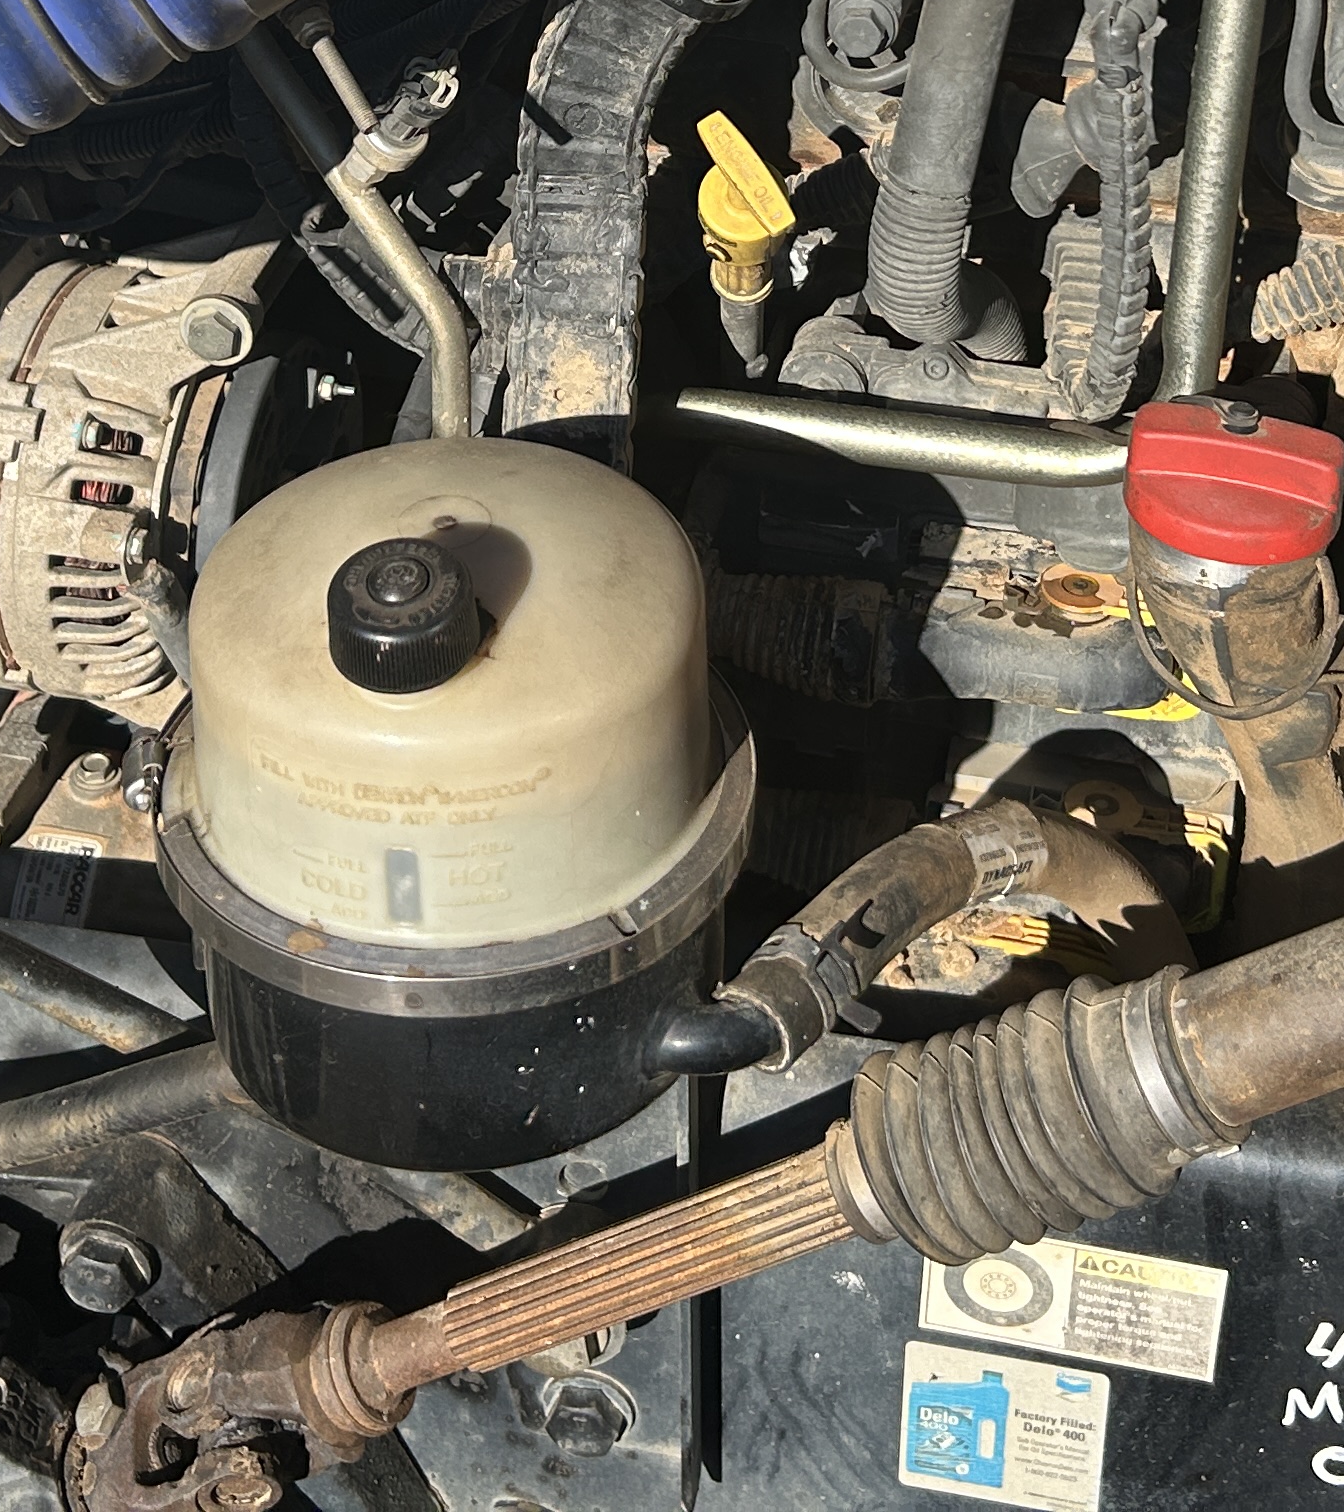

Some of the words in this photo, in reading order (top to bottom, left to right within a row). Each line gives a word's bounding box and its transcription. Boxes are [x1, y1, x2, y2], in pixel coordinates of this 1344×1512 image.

[753, 185, 775, 214] OIL
[260, 752, 295, 781] FILL
[327, 855, 367, 874] FULL
[448, 861, 506, 888] HOT
[65, 847, 94, 916] PACCAR
[301, 868, 367, 901] COLD
[1079, 1278, 1131, 1297] Maintain
[920, 1407, 960, 1426] Delo
[920, 1421, 949, 1432] 400
[1014, 1408, 1057, 1426] Factory
[1060, 1416, 1097, 1432] Filled:
[1063, 1429, 1086, 1443] 400
